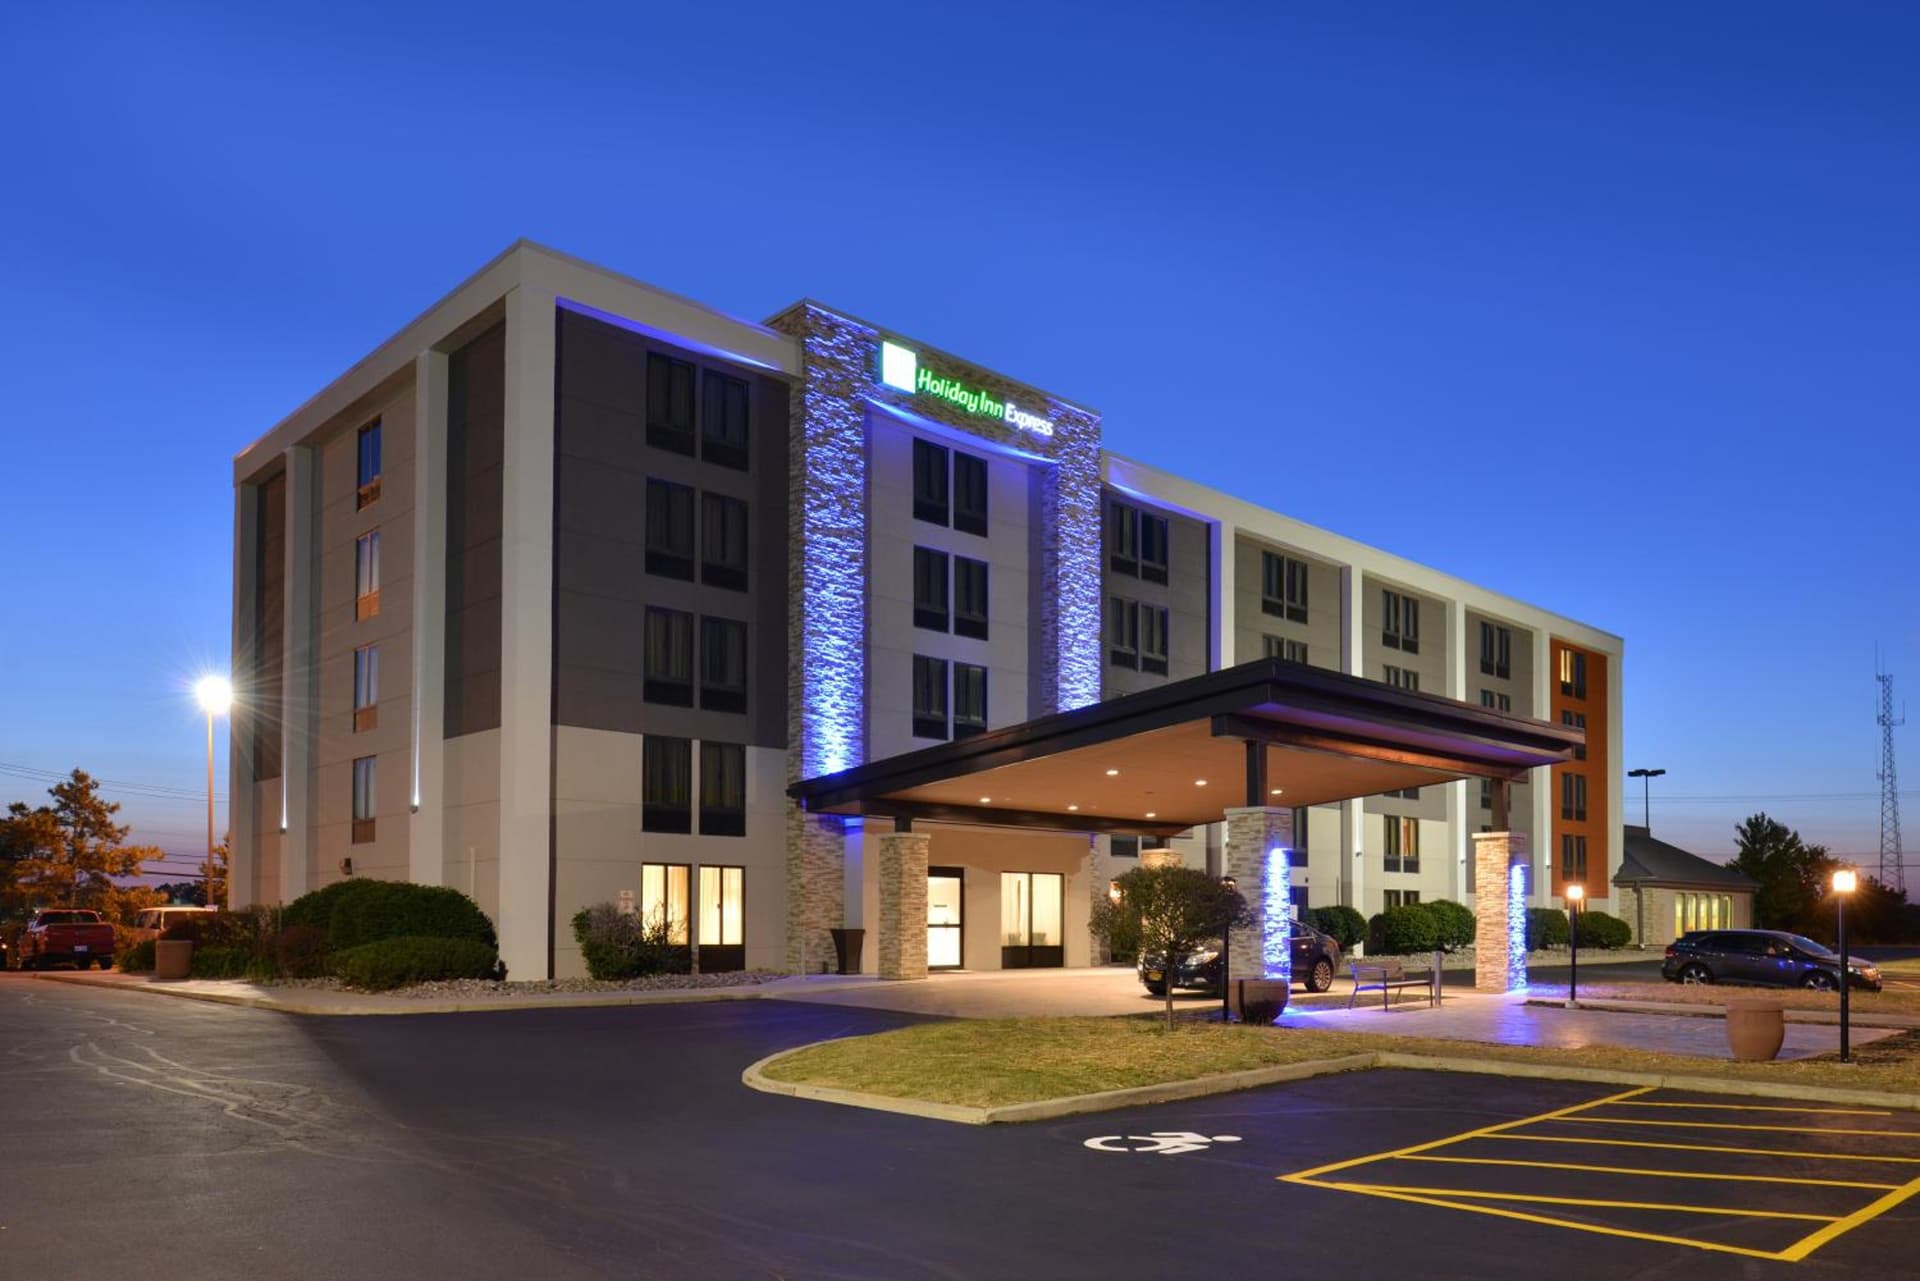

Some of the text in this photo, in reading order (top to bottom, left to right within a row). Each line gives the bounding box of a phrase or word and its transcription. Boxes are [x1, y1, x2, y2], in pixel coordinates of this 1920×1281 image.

[918, 368, 1054, 436] Holiday Inn Express
